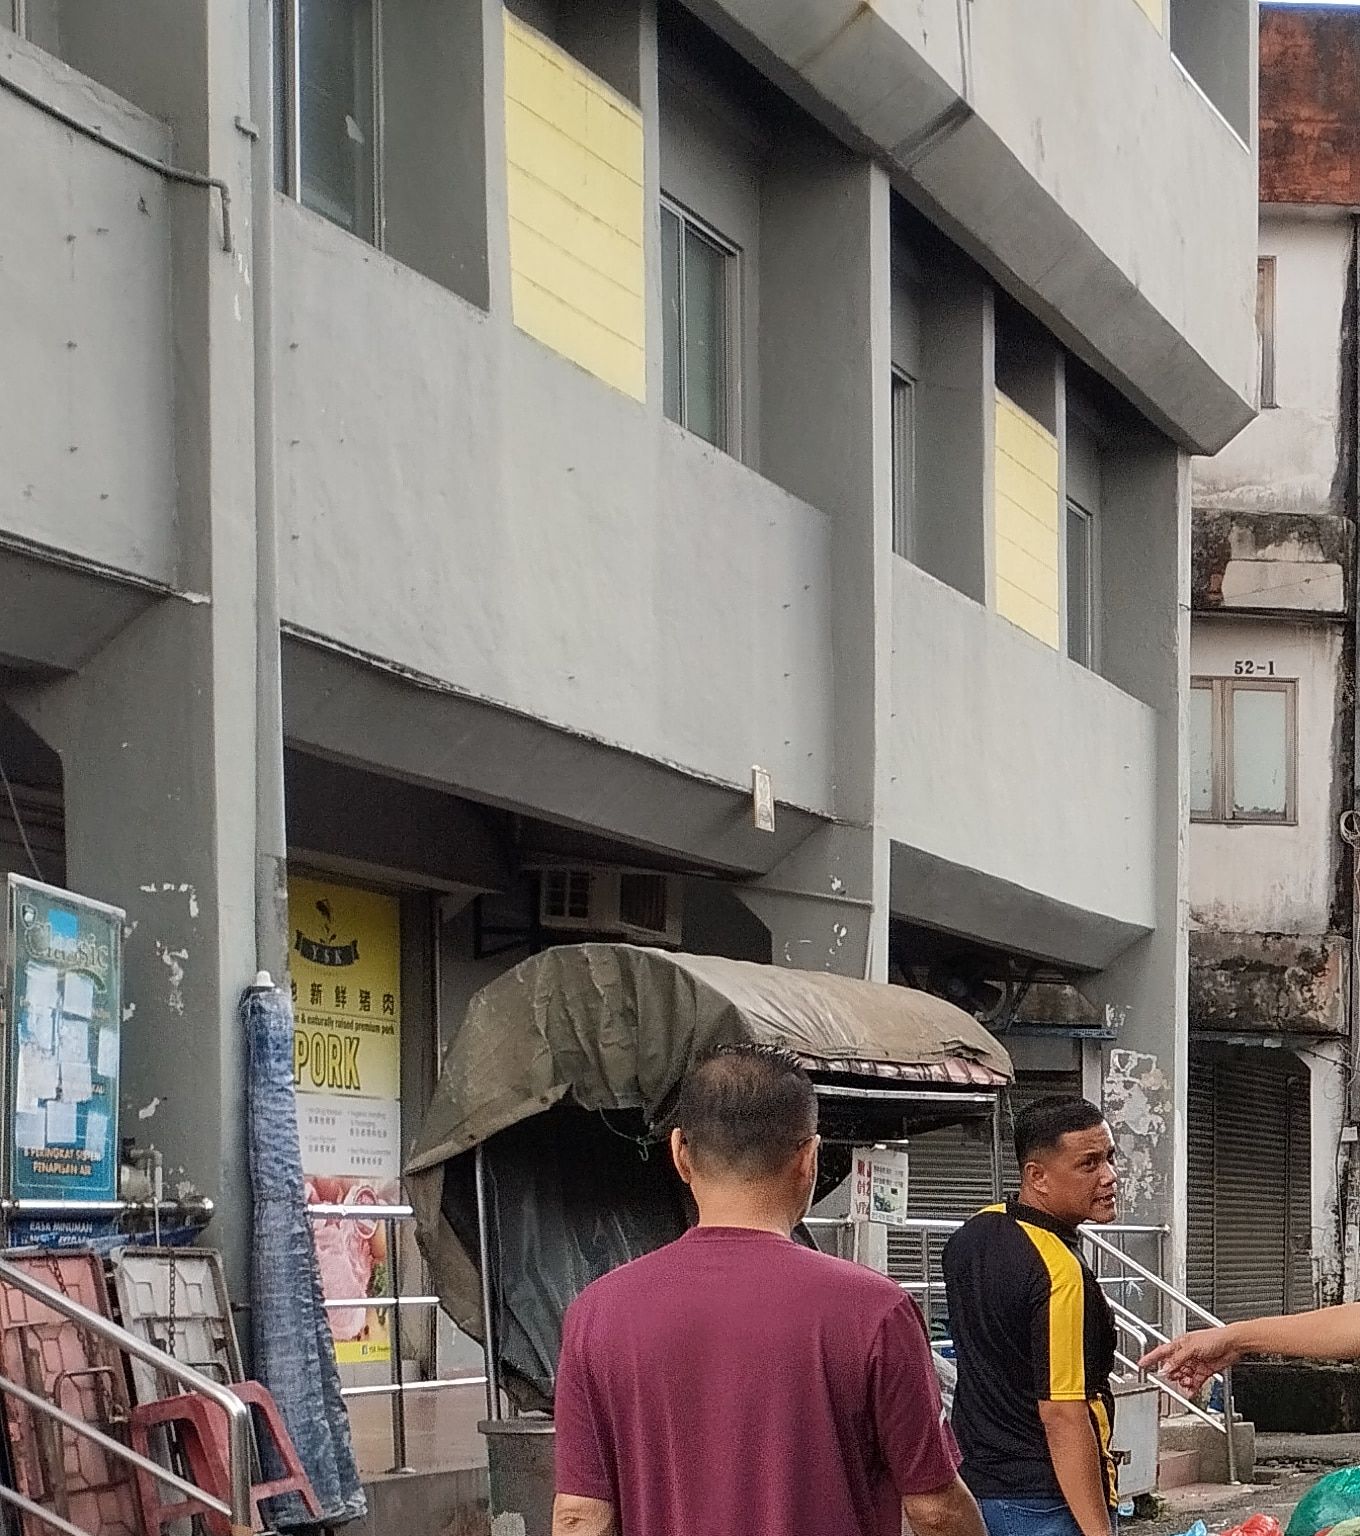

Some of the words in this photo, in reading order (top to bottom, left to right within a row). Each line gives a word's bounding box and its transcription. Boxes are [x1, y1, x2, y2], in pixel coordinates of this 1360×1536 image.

[1234, 660, 1275, 676] 52-1
[312, 944, 342, 965] YSK
[301, 1013, 307, 1024] &
[307, 1015, 335, 1030] naturally
[355, 1022, 381, 1036] premium
[381, 1024, 395, 1037] pork
[294, 1029, 361, 1090] PORK
